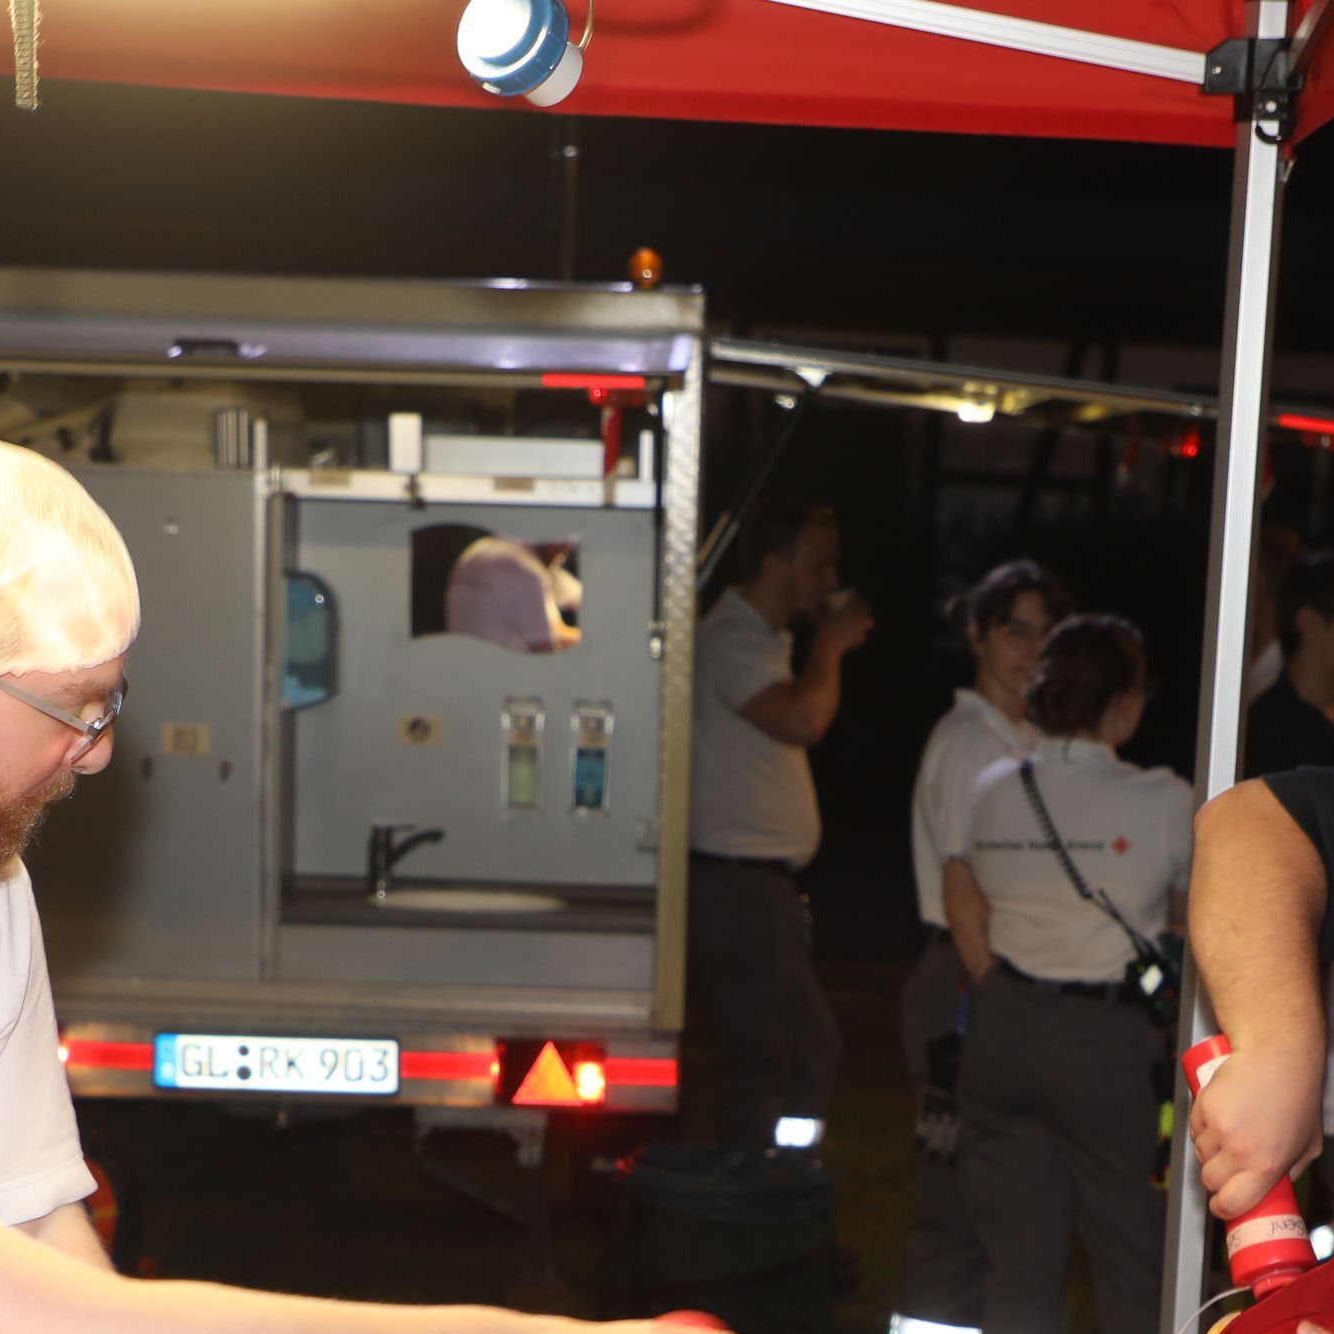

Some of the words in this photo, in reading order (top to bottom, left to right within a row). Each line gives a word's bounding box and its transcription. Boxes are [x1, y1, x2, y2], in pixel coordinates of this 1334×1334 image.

[181, 1043, 229, 1078] GL
[258, 1046, 305, 1080] RK
[319, 1048, 389, 1082] 903
